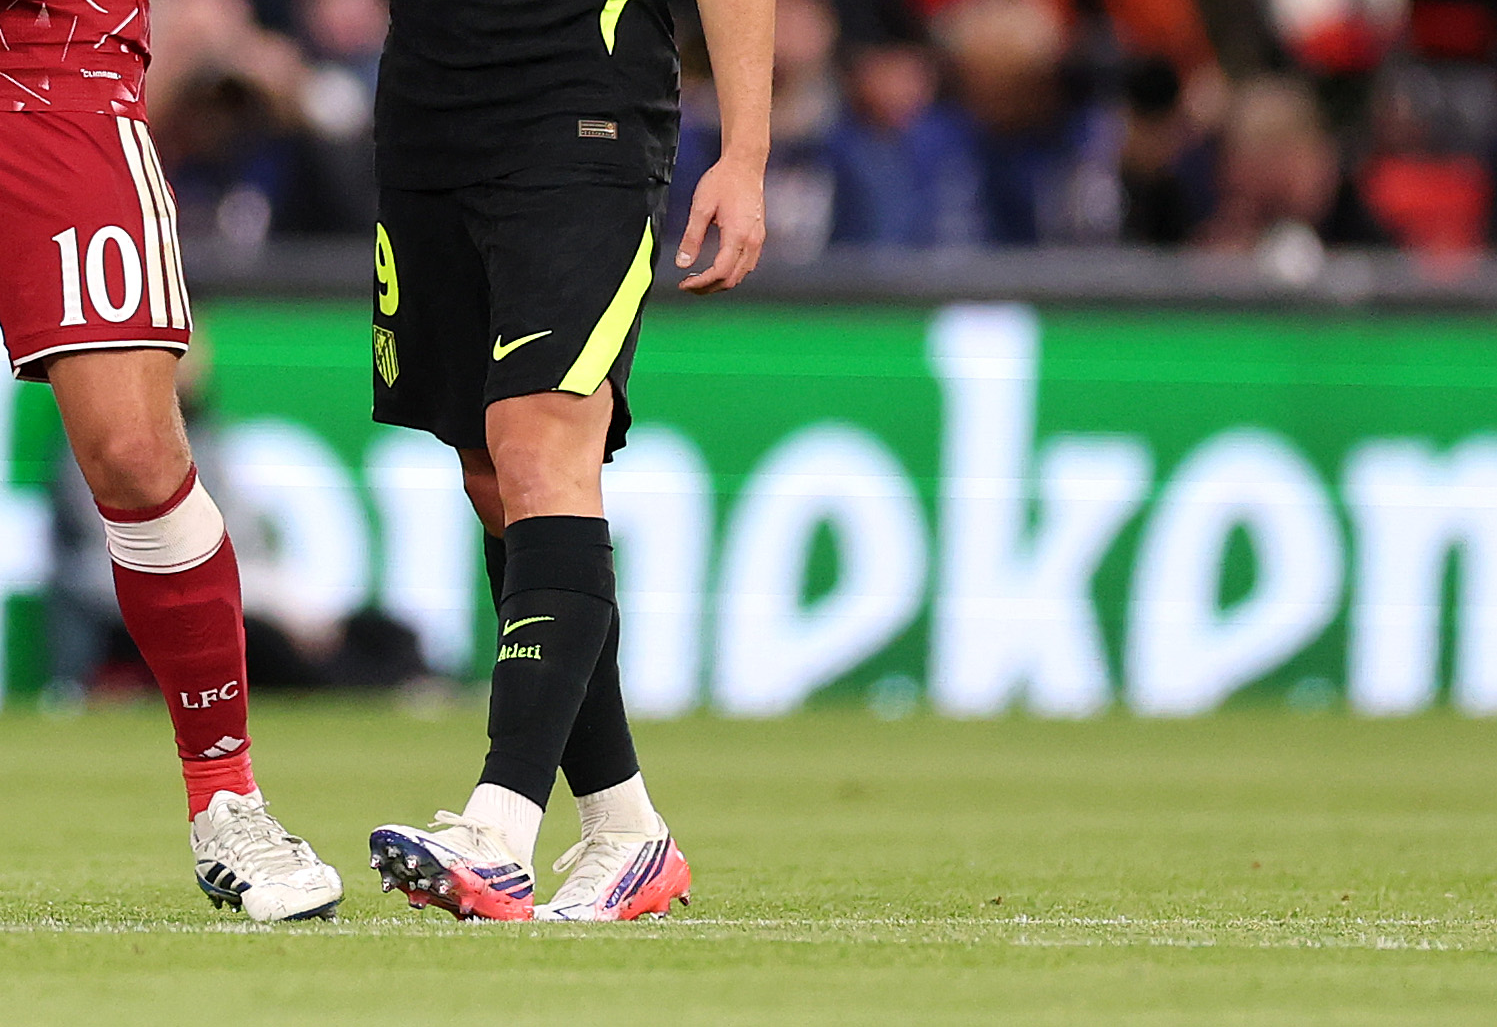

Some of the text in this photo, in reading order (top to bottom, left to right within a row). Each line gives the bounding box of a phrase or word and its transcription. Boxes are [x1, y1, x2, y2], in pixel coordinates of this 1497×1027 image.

[51, 225, 143, 326] 10
[375, 222, 399, 315] 9
[497, 642, 542, 662] Atleti
[179, 680, 239, 709] LFC
